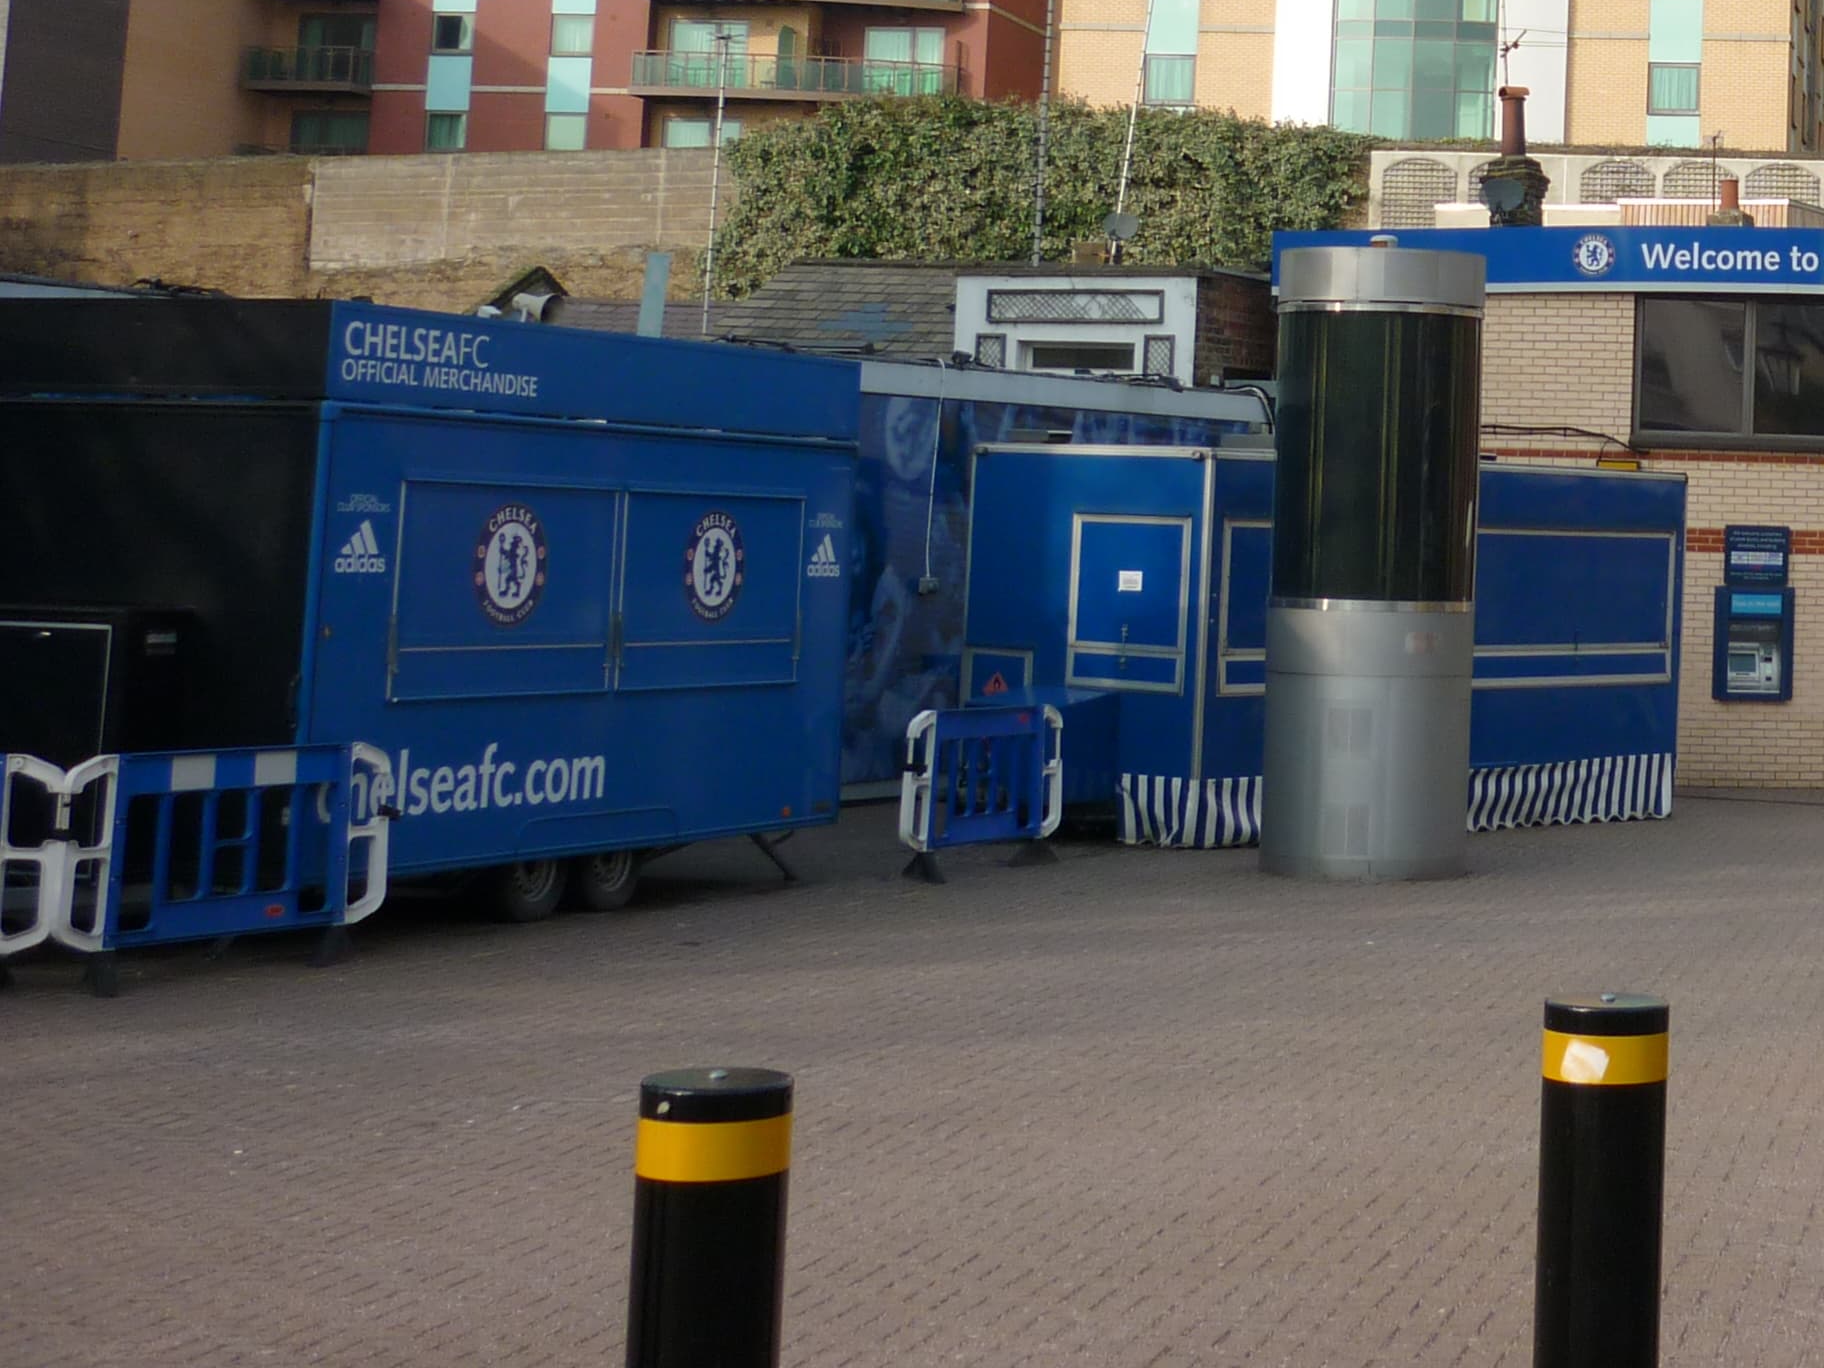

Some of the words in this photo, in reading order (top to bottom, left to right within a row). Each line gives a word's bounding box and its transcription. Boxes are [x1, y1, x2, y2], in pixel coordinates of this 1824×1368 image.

[1640, 241, 1781, 271] Welcome
[1790, 245, 1820, 273] to
[344, 320, 490, 369] CHELSEAFC
[341, 358, 418, 386] OFFICIAL
[423, 366, 538, 398] MERCHANDISE
[489, 507, 538, 535] CHELSEA
[696, 513, 737, 539] CHELSEA
[334, 554, 386, 573] adidas
[807, 564, 840, 577] adidas
